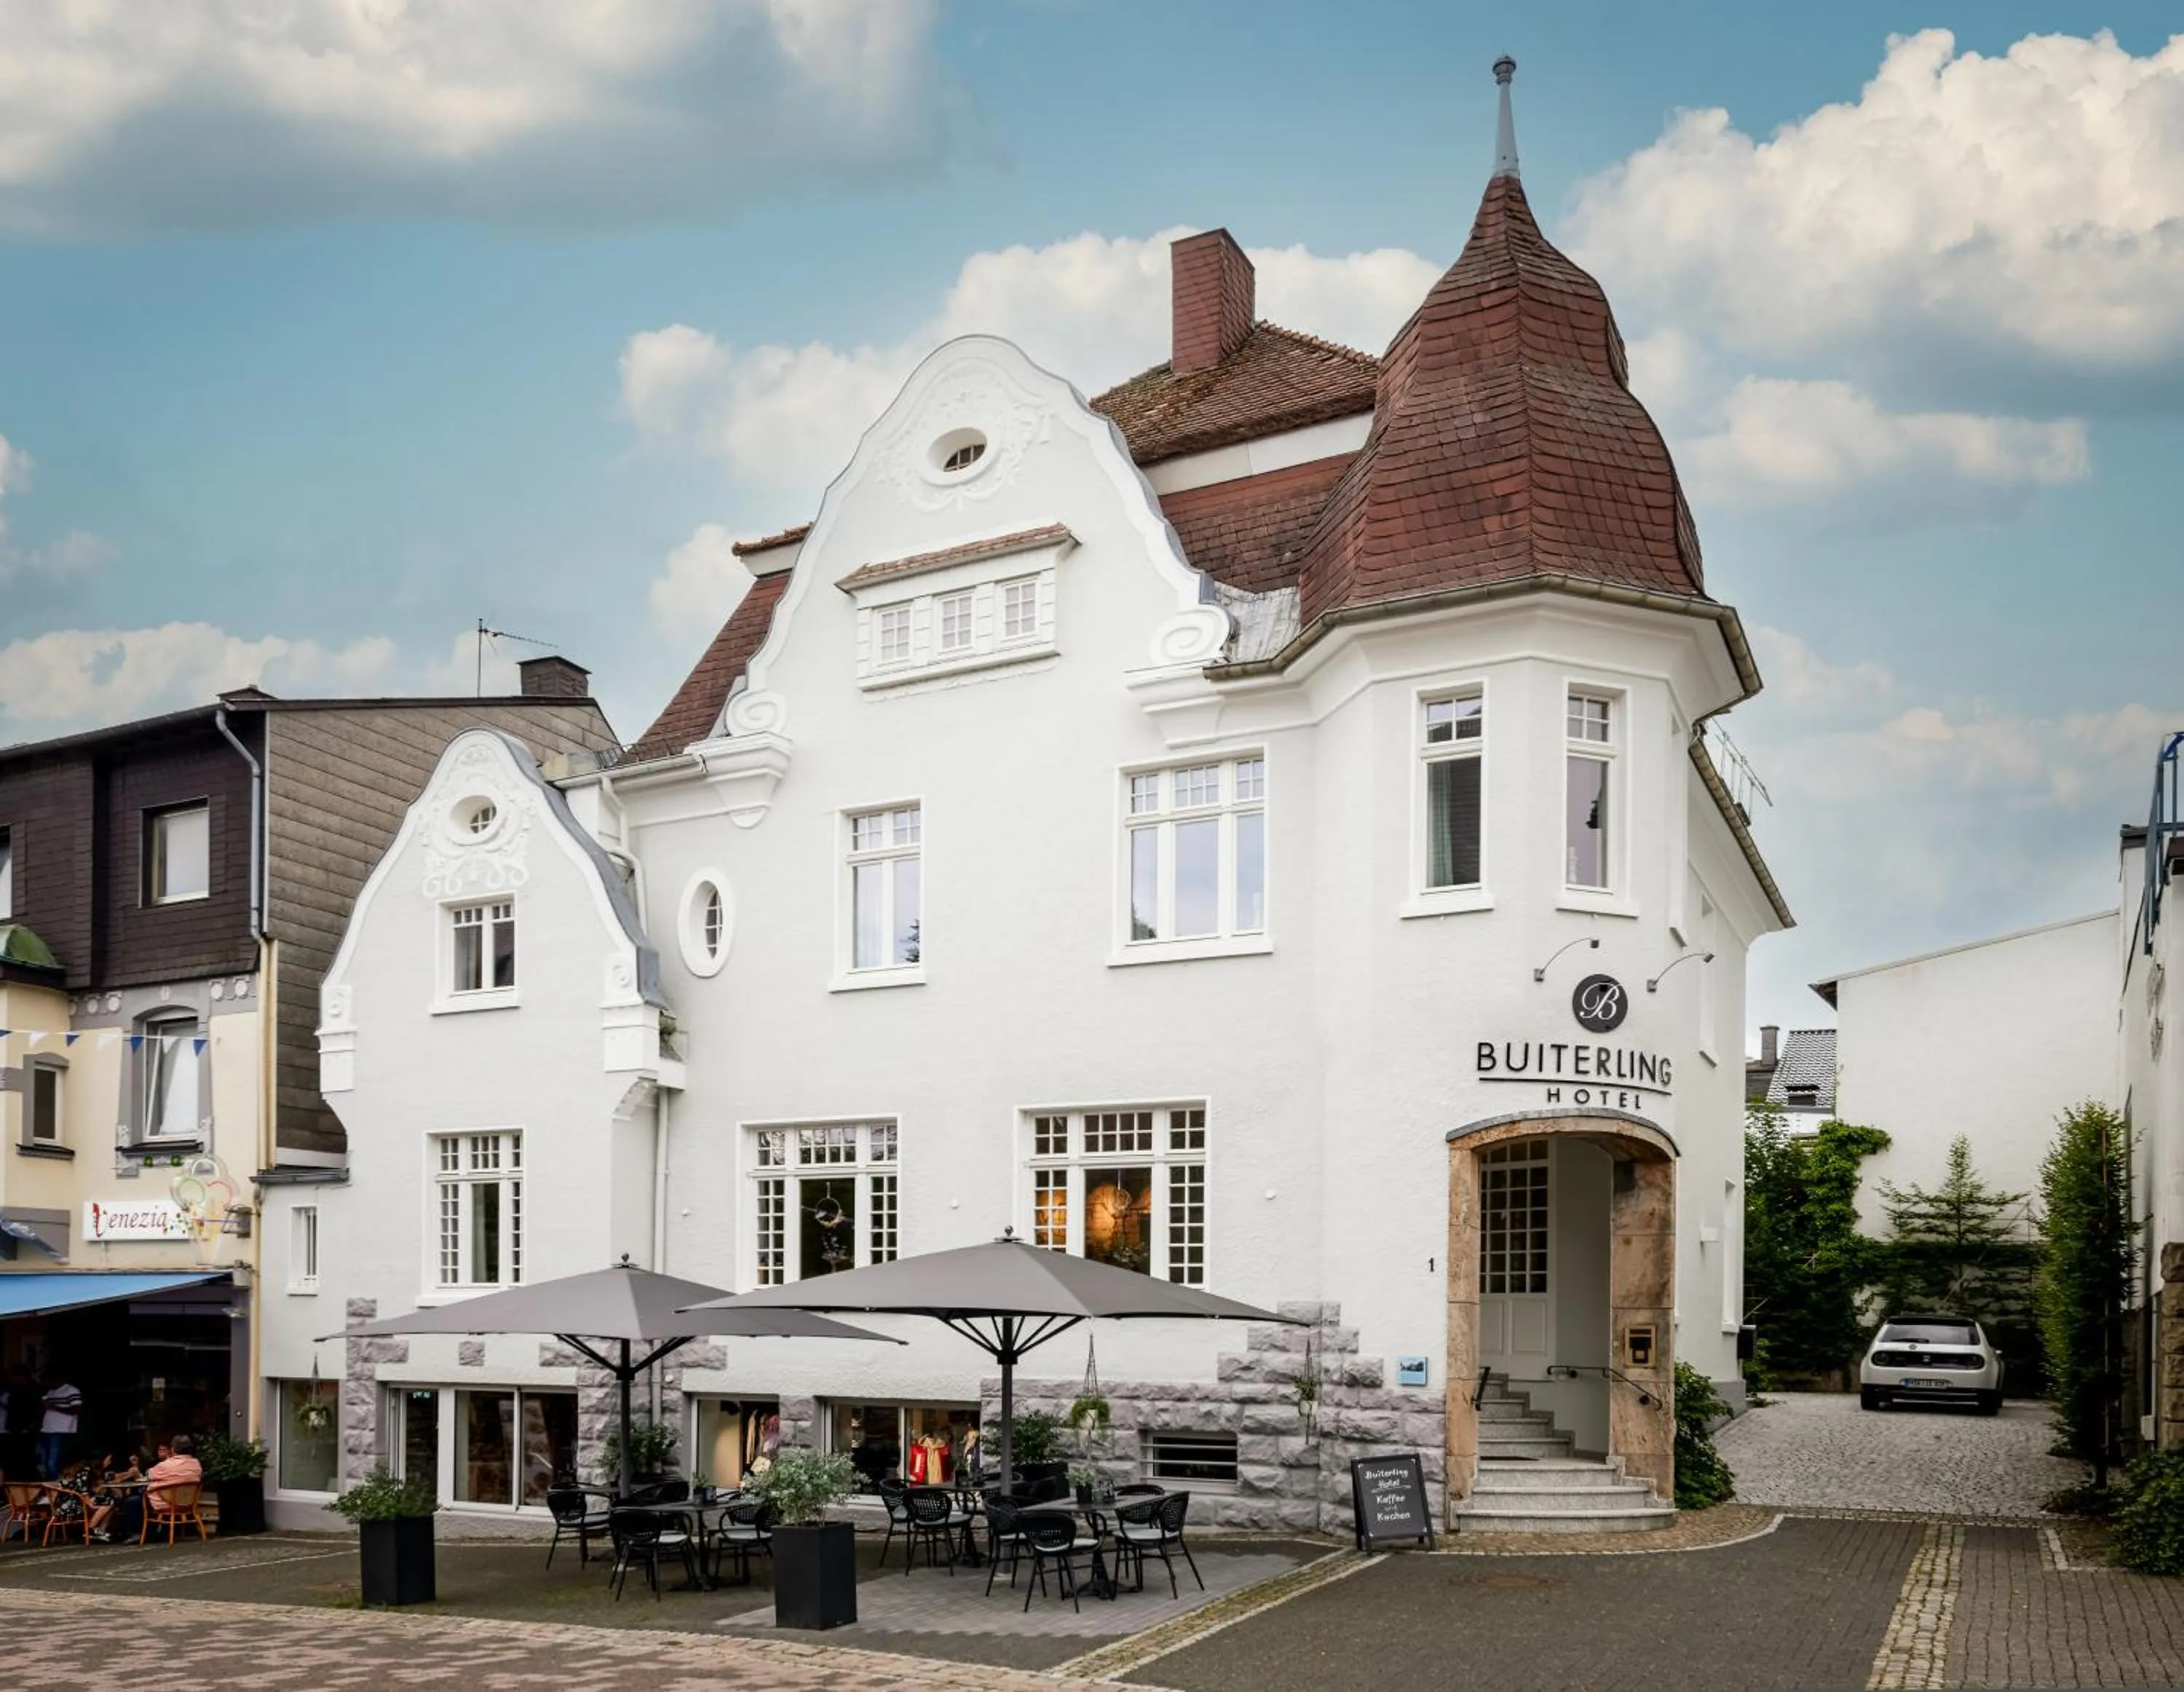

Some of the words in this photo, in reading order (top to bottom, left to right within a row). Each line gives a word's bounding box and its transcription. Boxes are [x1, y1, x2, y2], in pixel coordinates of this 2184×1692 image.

[1579, 982, 1621, 1020] B
[1477, 1042, 1672, 1086] BUITERLING
[1547, 1088, 1642, 1109] HOTEL
[1428, 1257, 1435, 1273] 1
[1365, 1469, 1408, 1479] Buiterling
[1377, 1494, 1405, 1504] Kaffee
[1377, 1512, 1409, 1522] Kuchen
